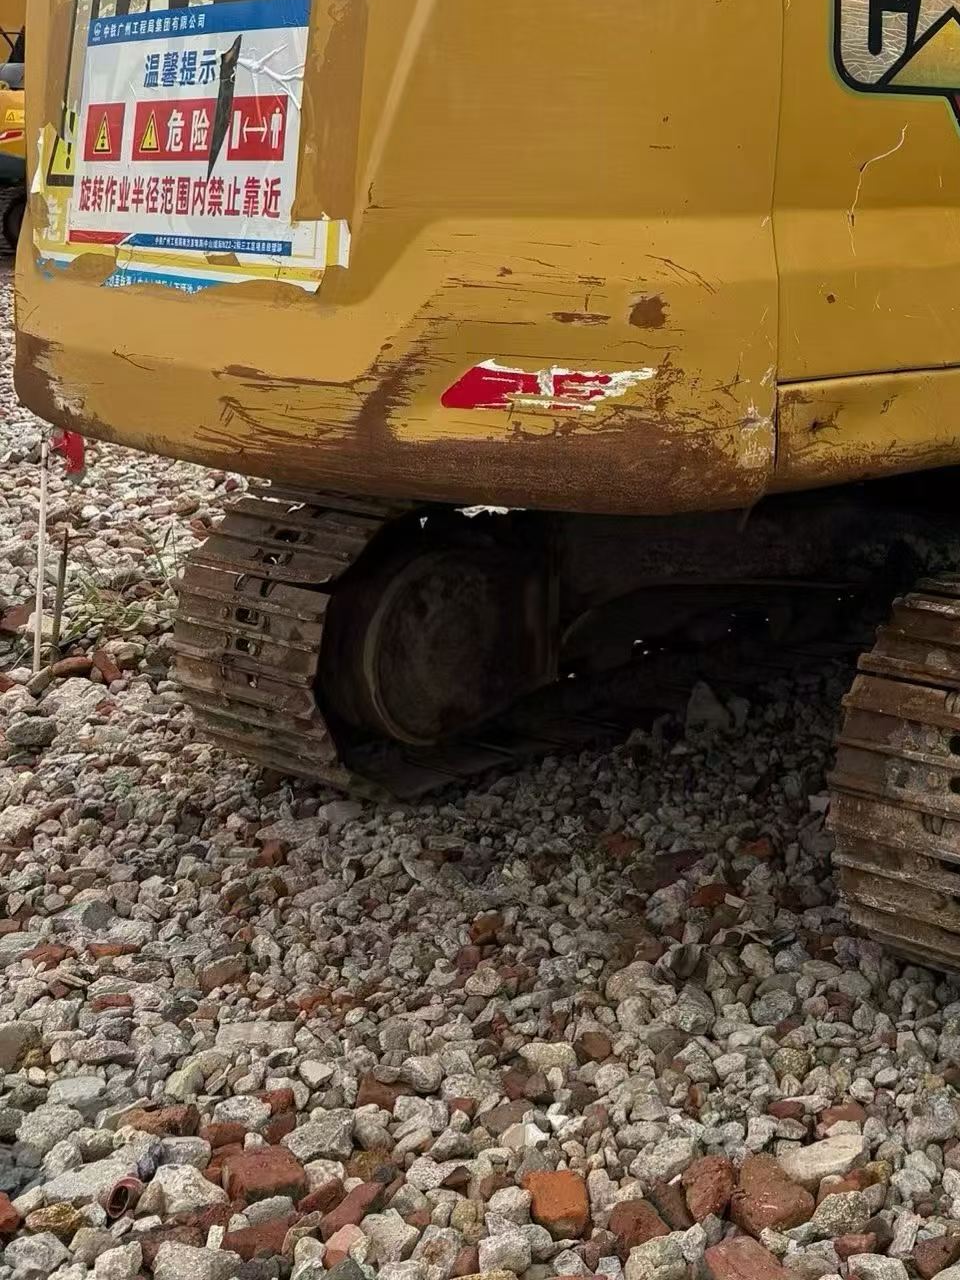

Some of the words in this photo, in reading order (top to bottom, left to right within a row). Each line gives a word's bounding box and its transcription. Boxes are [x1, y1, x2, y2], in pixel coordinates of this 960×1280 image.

[103, 13, 205, 39] 中铁广州工程局集团有限公司
[143, 49, 217, 88] 温馨提示
[165, 108, 210, 153] 危险
[79, 176, 281, 218] 旋转作业半径范围内禁止靠近
